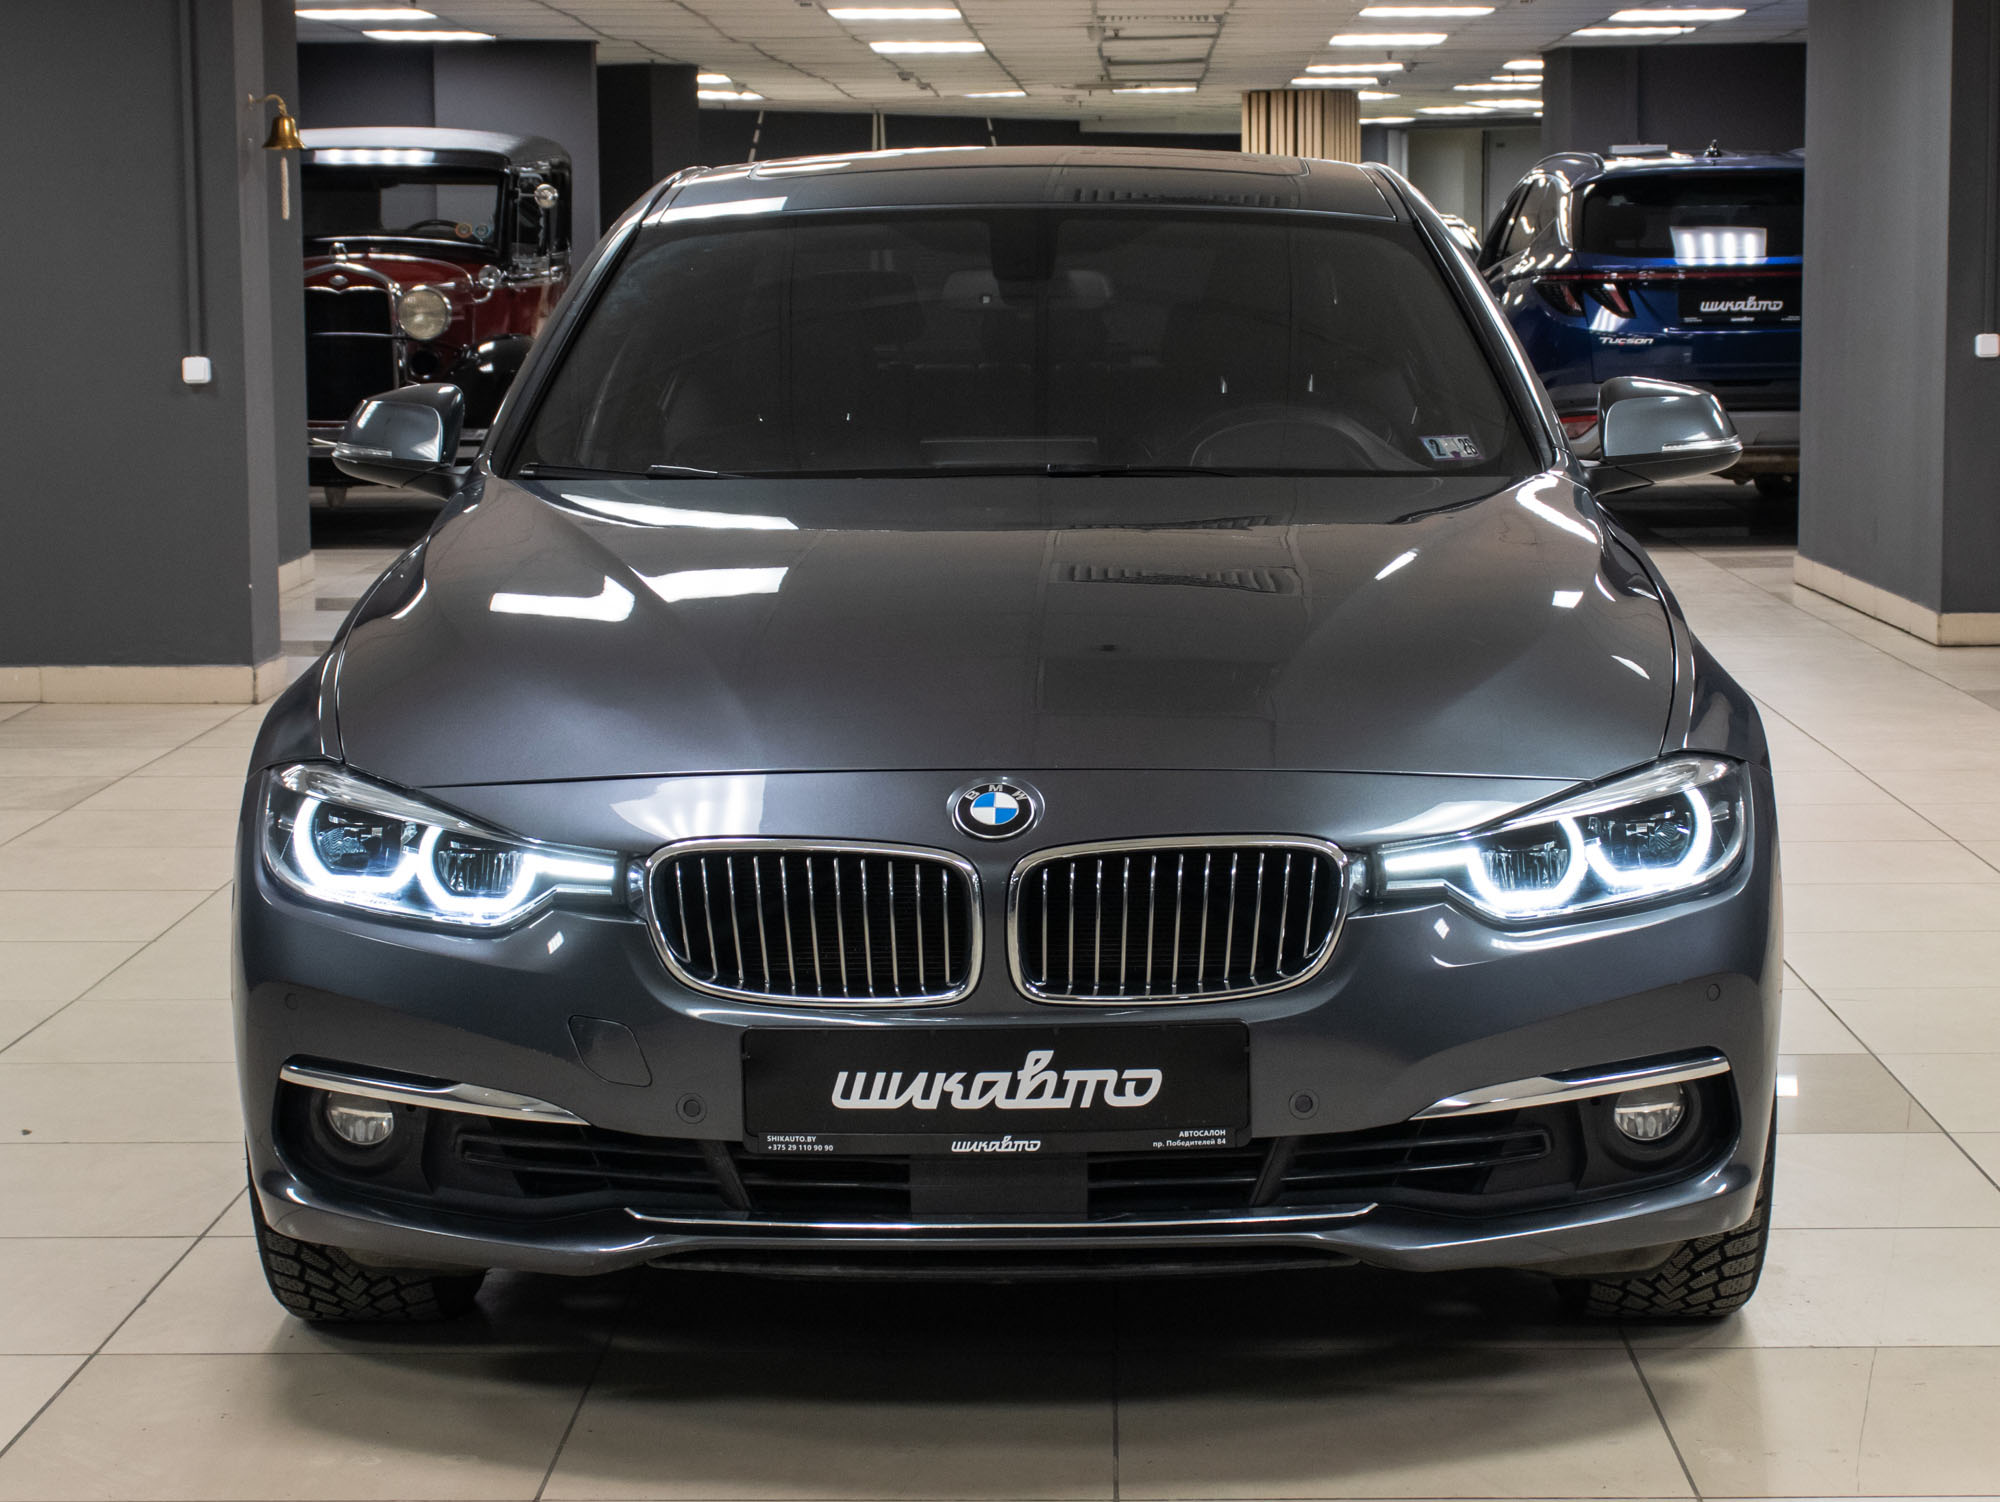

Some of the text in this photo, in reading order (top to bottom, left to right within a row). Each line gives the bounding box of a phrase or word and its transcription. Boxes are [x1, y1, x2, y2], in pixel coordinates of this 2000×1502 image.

[965, 784, 1028, 801] BMW
[1178, 1129, 1226, 1137] АВТОСАЛОН
[1166, 1138, 1215, 1147] Победителей
